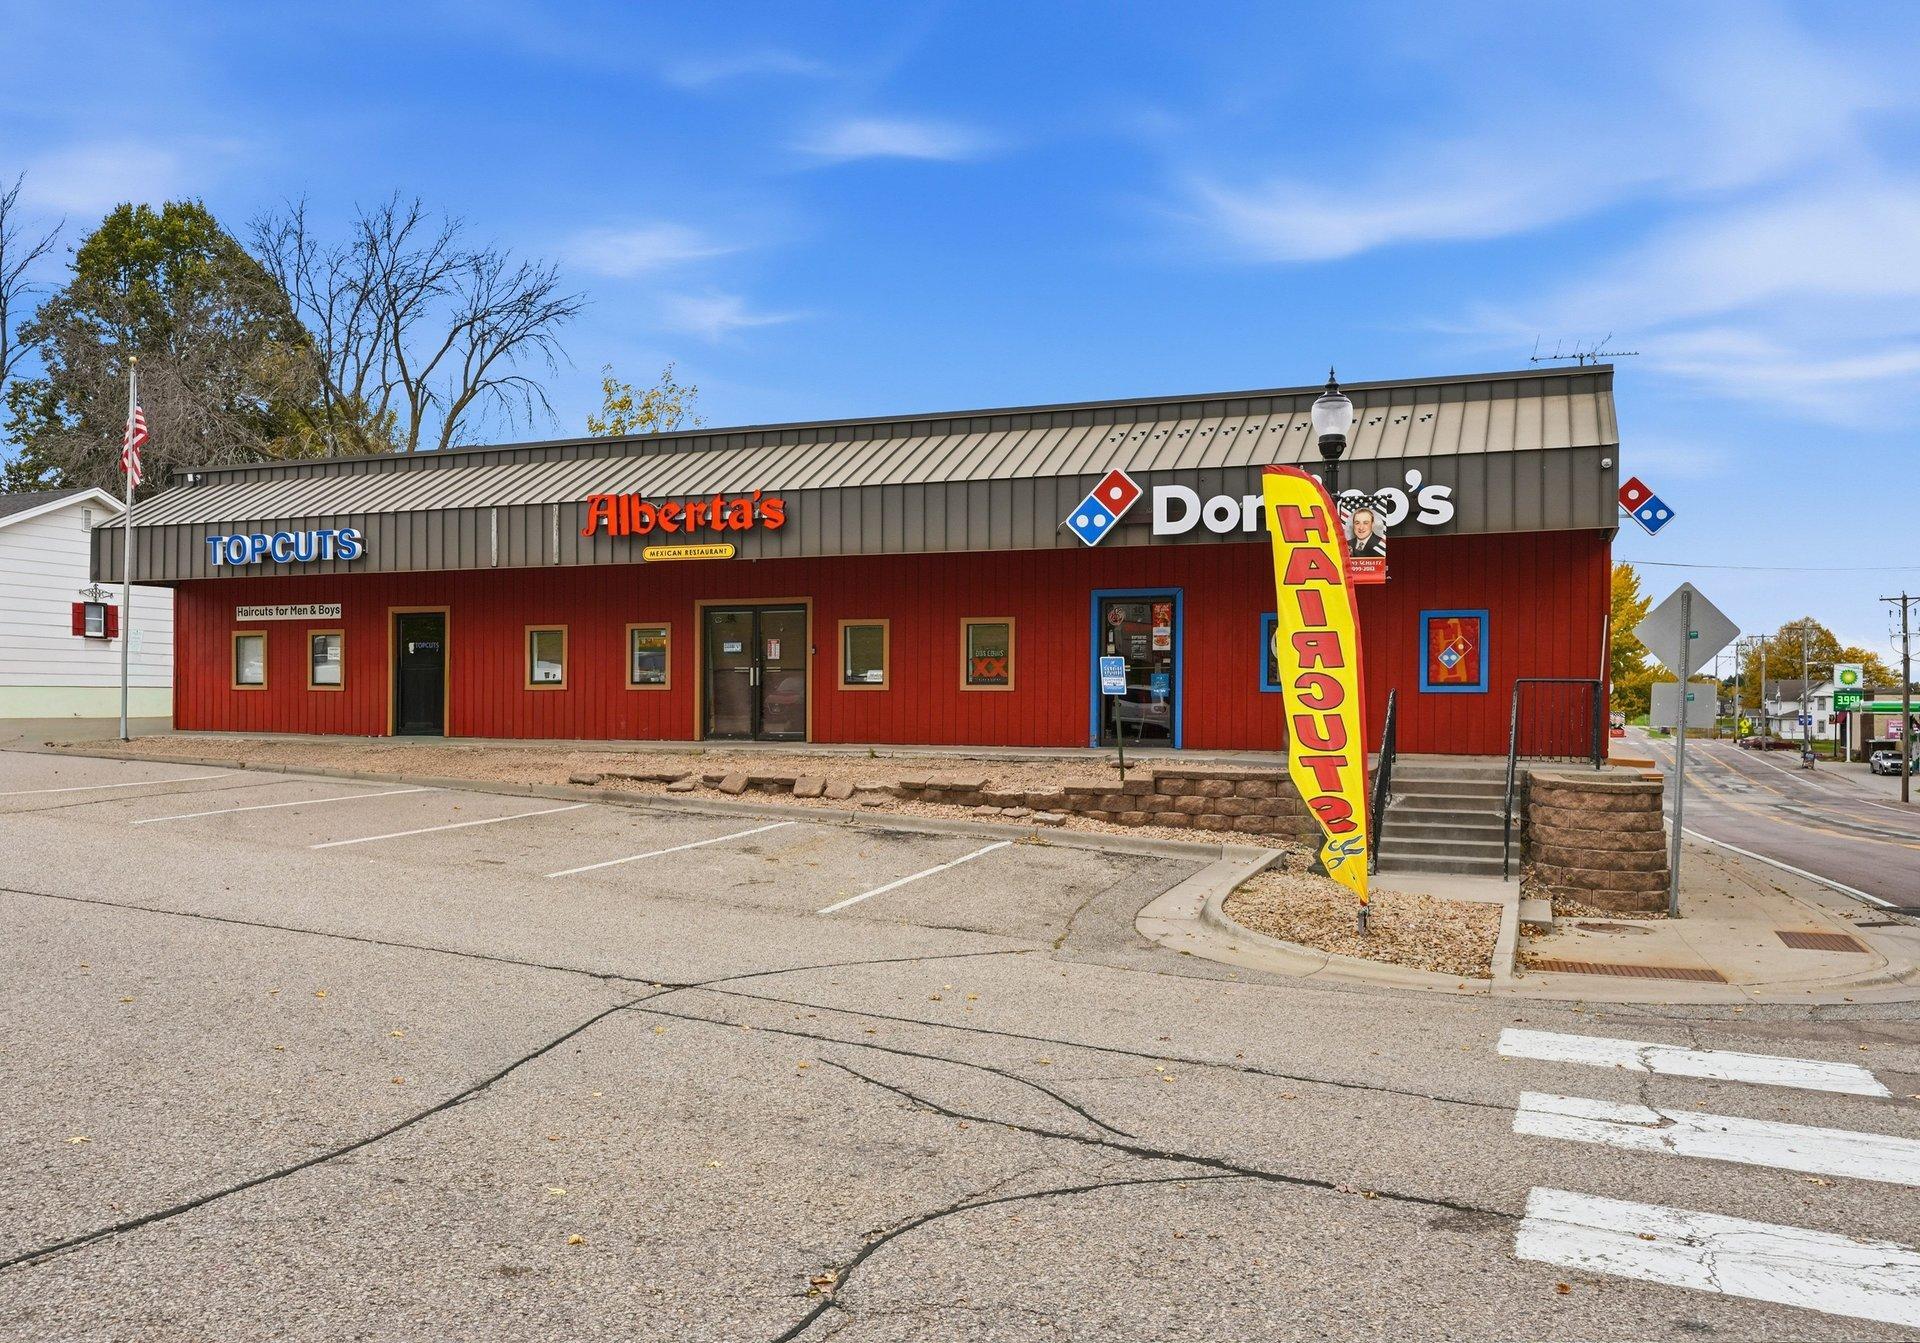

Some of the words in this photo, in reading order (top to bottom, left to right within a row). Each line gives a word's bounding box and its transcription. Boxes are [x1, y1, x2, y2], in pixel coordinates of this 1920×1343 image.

[581, 489, 787, 537] Alberta's
[1153, 469, 1454, 535] Doo's
[206, 528, 362, 566] TOPCUTS
[649, 549, 682, 557] MEXICAN
[684, 548, 727, 556] RESTAURANT
[237, 605, 274, 617] Haircuts
[275, 605, 289, 616] for
[290, 605, 308, 616] Men
[309, 605, 316, 615] &
[318, 604, 341, 617] Boys
